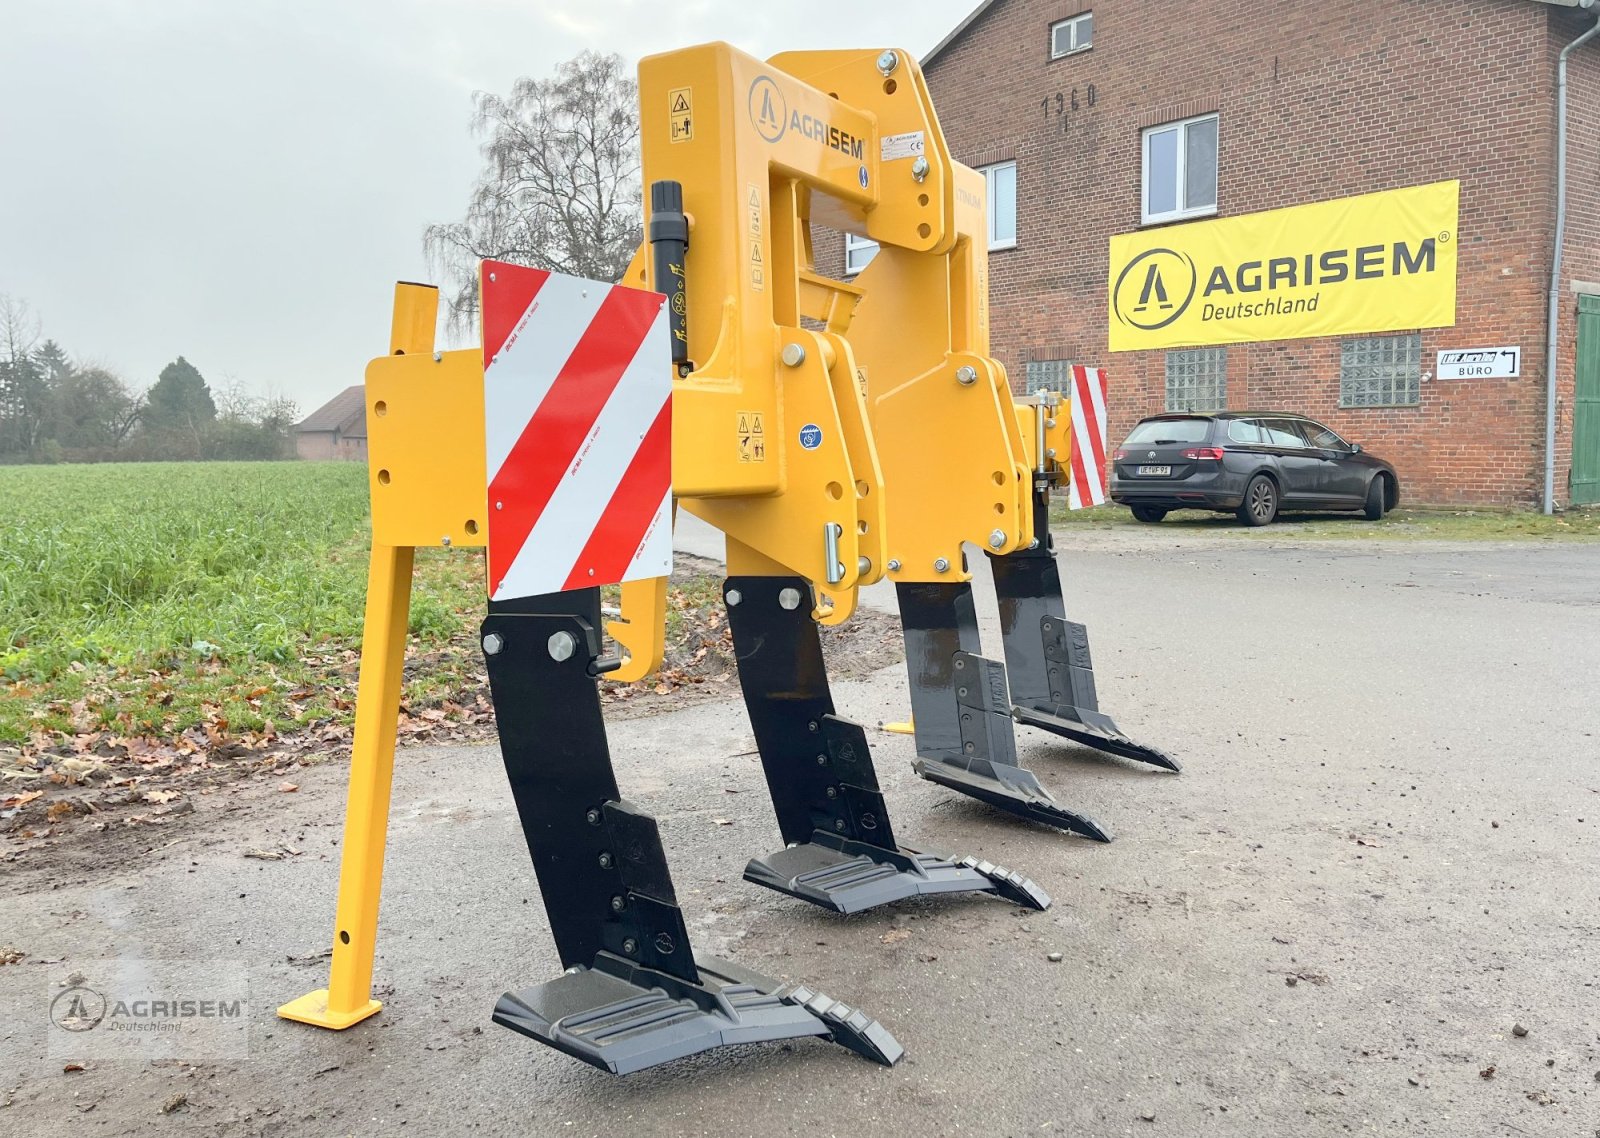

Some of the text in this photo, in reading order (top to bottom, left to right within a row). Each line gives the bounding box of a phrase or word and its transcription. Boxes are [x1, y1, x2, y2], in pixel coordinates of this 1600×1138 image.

[1041, 84, 1095, 118] 1960
[790, 110, 863, 160] AGRISEM
[1203, 237, 1436, 297] AGRISEM
[1202, 293, 1319, 322] Deutschland
[1459, 365, 1492, 375] BÜRO
